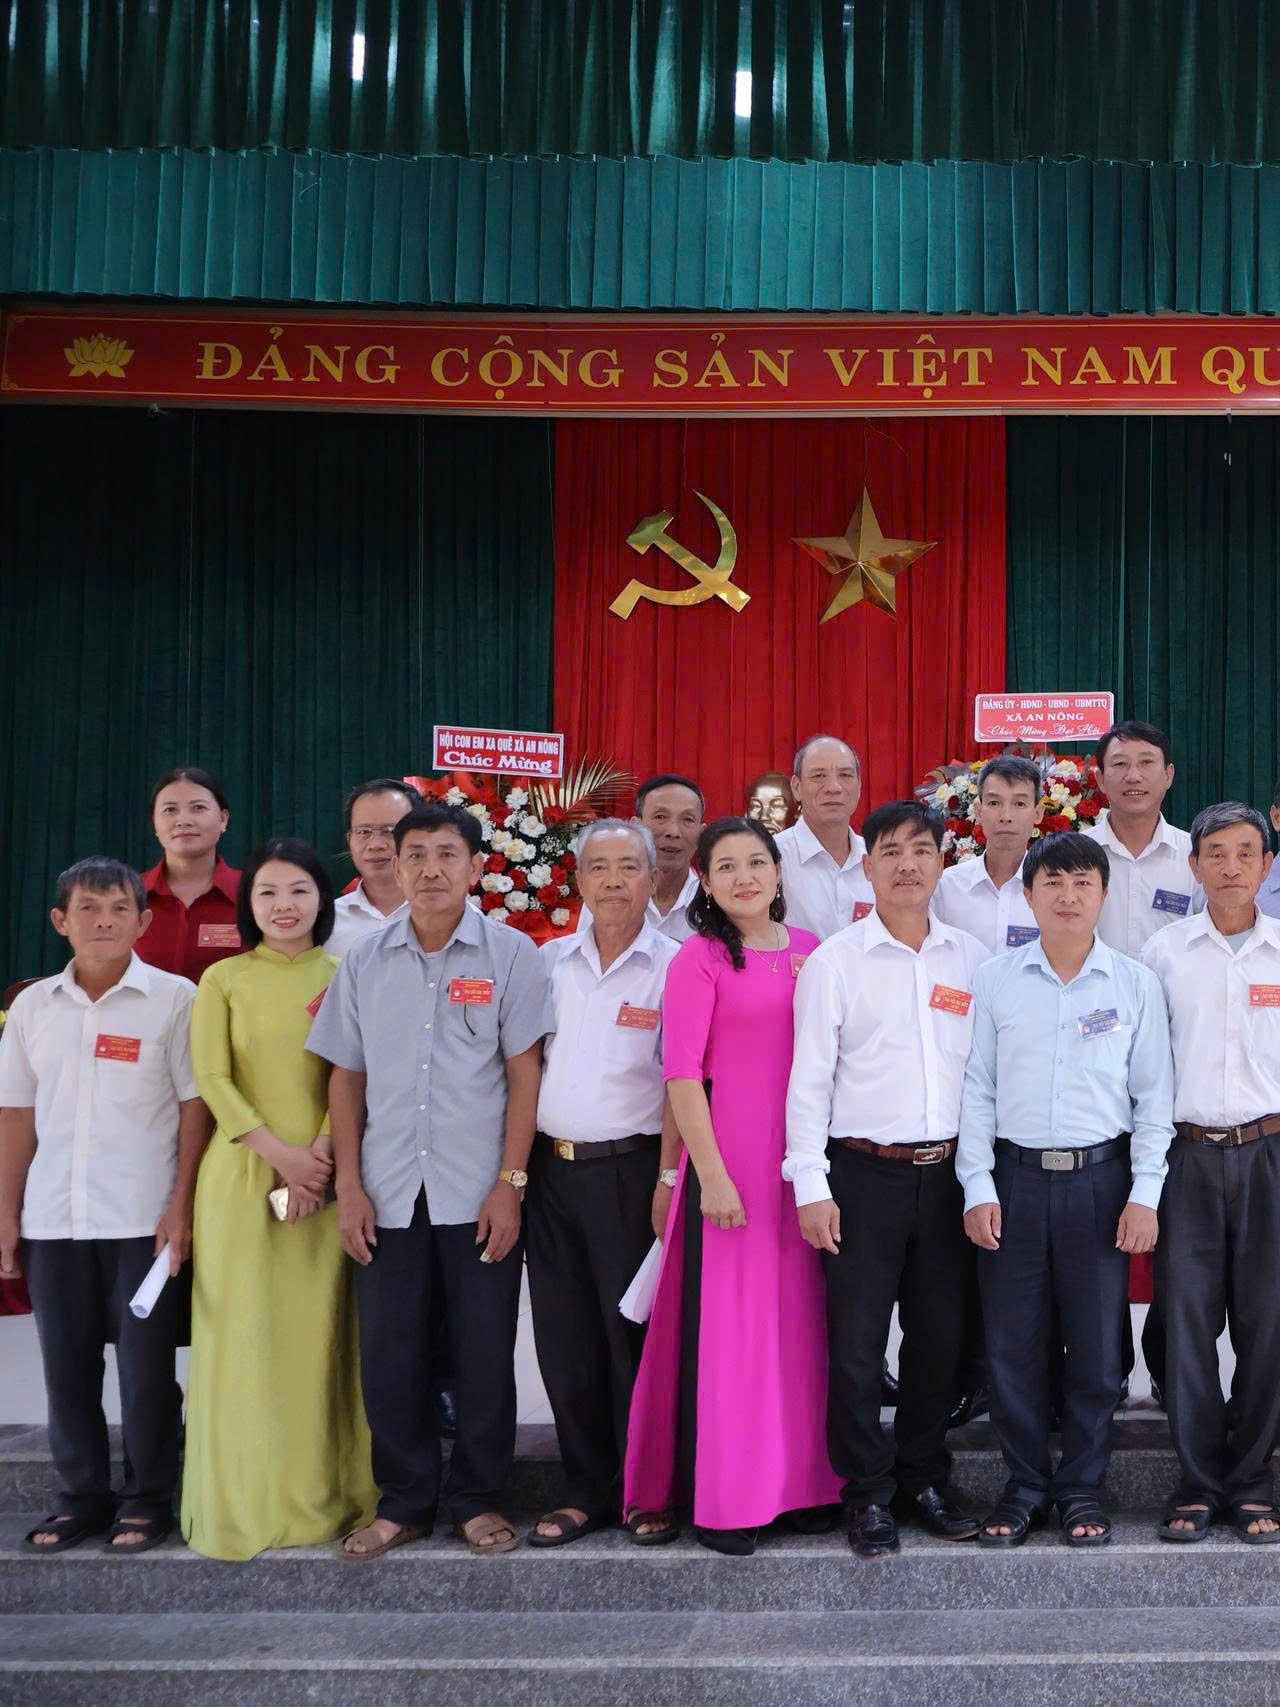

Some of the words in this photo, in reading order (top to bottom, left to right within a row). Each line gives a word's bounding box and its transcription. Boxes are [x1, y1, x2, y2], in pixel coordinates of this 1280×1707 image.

[196, 326, 400, 384] ĐẢNG
[431, 335, 625, 400] CỘNG
[652, 332, 792, 388] SẢN
[824, 334, 993, 398] VIỆT
[1022, 346, 1178, 385] NAM
[1005, 712, 1023, 721] XÃ
[1026, 713, 1044, 721] AN
[1047, 711, 1084, 721] NÔNG
[1048, 699, 1070, 708] UBND
[1075, 698, 1108, 710] UBMTTQ
[439, 731, 454, 750] HỘI
[454, 734, 471, 748] CON
[472, 736, 485, 749] EM
[486, 736, 496, 750] XA
[497, 736, 513, 752] QUÊ
[514, 737, 525, 752] XÃ
[525, 740, 537, 753] AN
[537, 738, 559, 755] NÔNG
[443, 750, 494, 767] Chúc
[496, 755, 553, 774] Mừng
